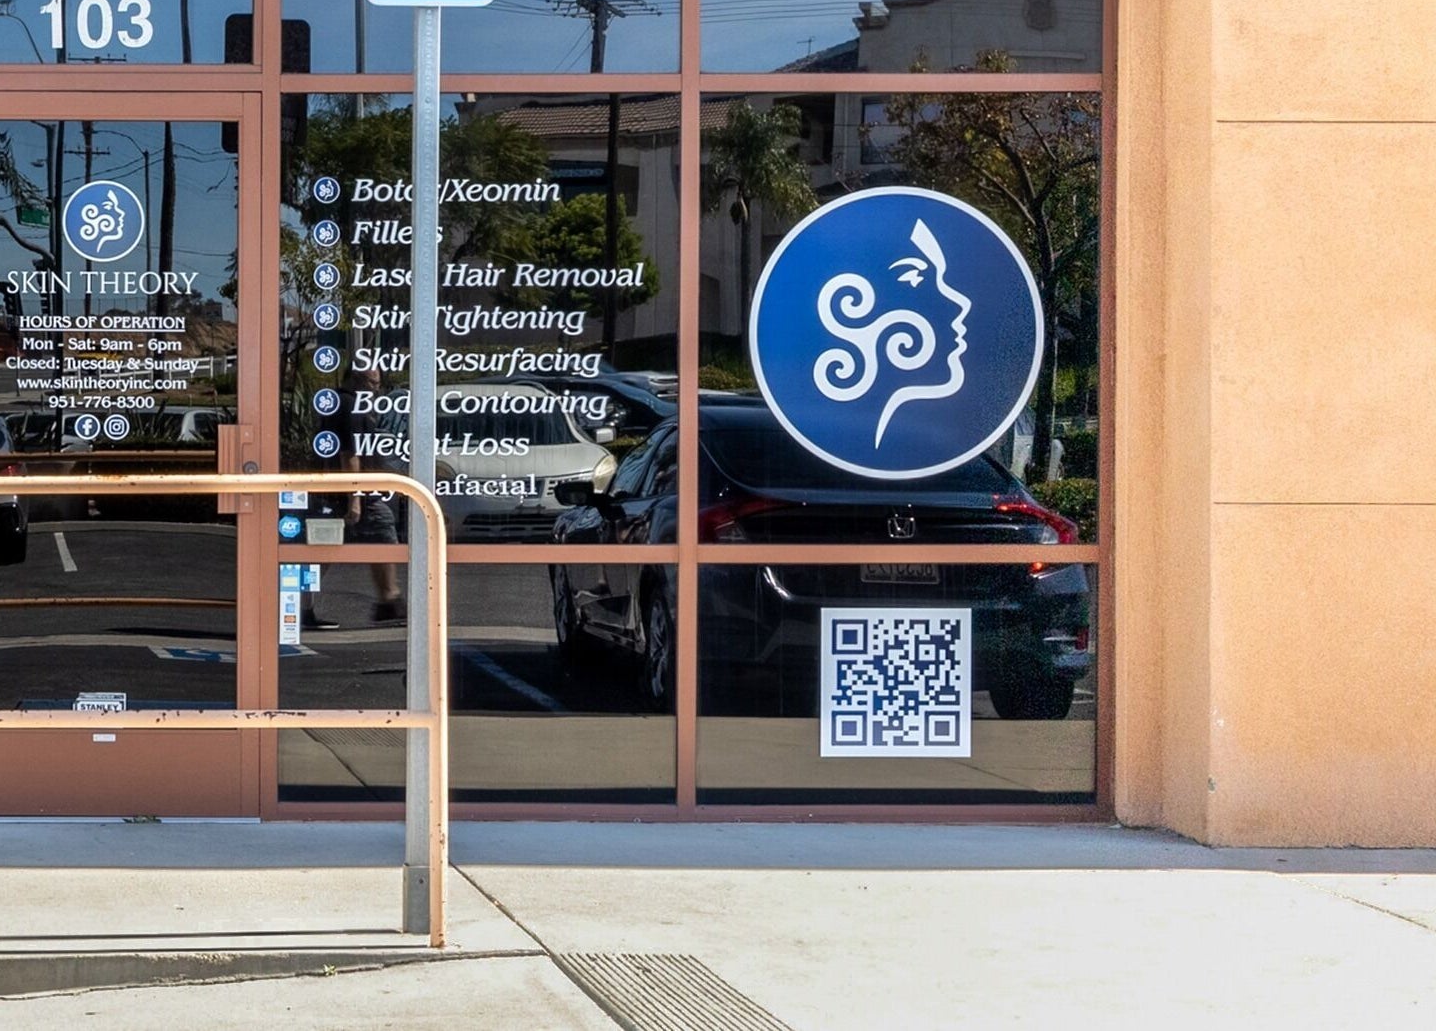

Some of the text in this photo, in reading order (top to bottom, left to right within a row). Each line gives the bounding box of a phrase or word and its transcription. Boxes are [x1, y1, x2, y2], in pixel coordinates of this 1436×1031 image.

[351, 177, 561, 205] Bot/Xeomin
[351, 220, 443, 246] Fille
[7, 270, 200, 295] SKIN THEORY
[351, 262, 645, 289] Las Hair Removal
[19, 315, 186, 330] HOURS OF OPERATION
[22, 338, 54, 350] Mon
[68, 337, 96, 351] Sat:
[100, 338, 133, 350] 9am
[147, 338, 182, 352] 6pm
[6, 357, 200, 373] Closed: Tuesday & Sunday
[17, 376, 187, 394] www.skintheoryinc.com
[49, 396, 155, 409] 951-776-8300
[351, 389, 610, 421] Bod Contouring
[460, 432, 531, 457] Loss
[352, 473, 539, 502] afacial
[80, 703, 119, 711] STANLEY
